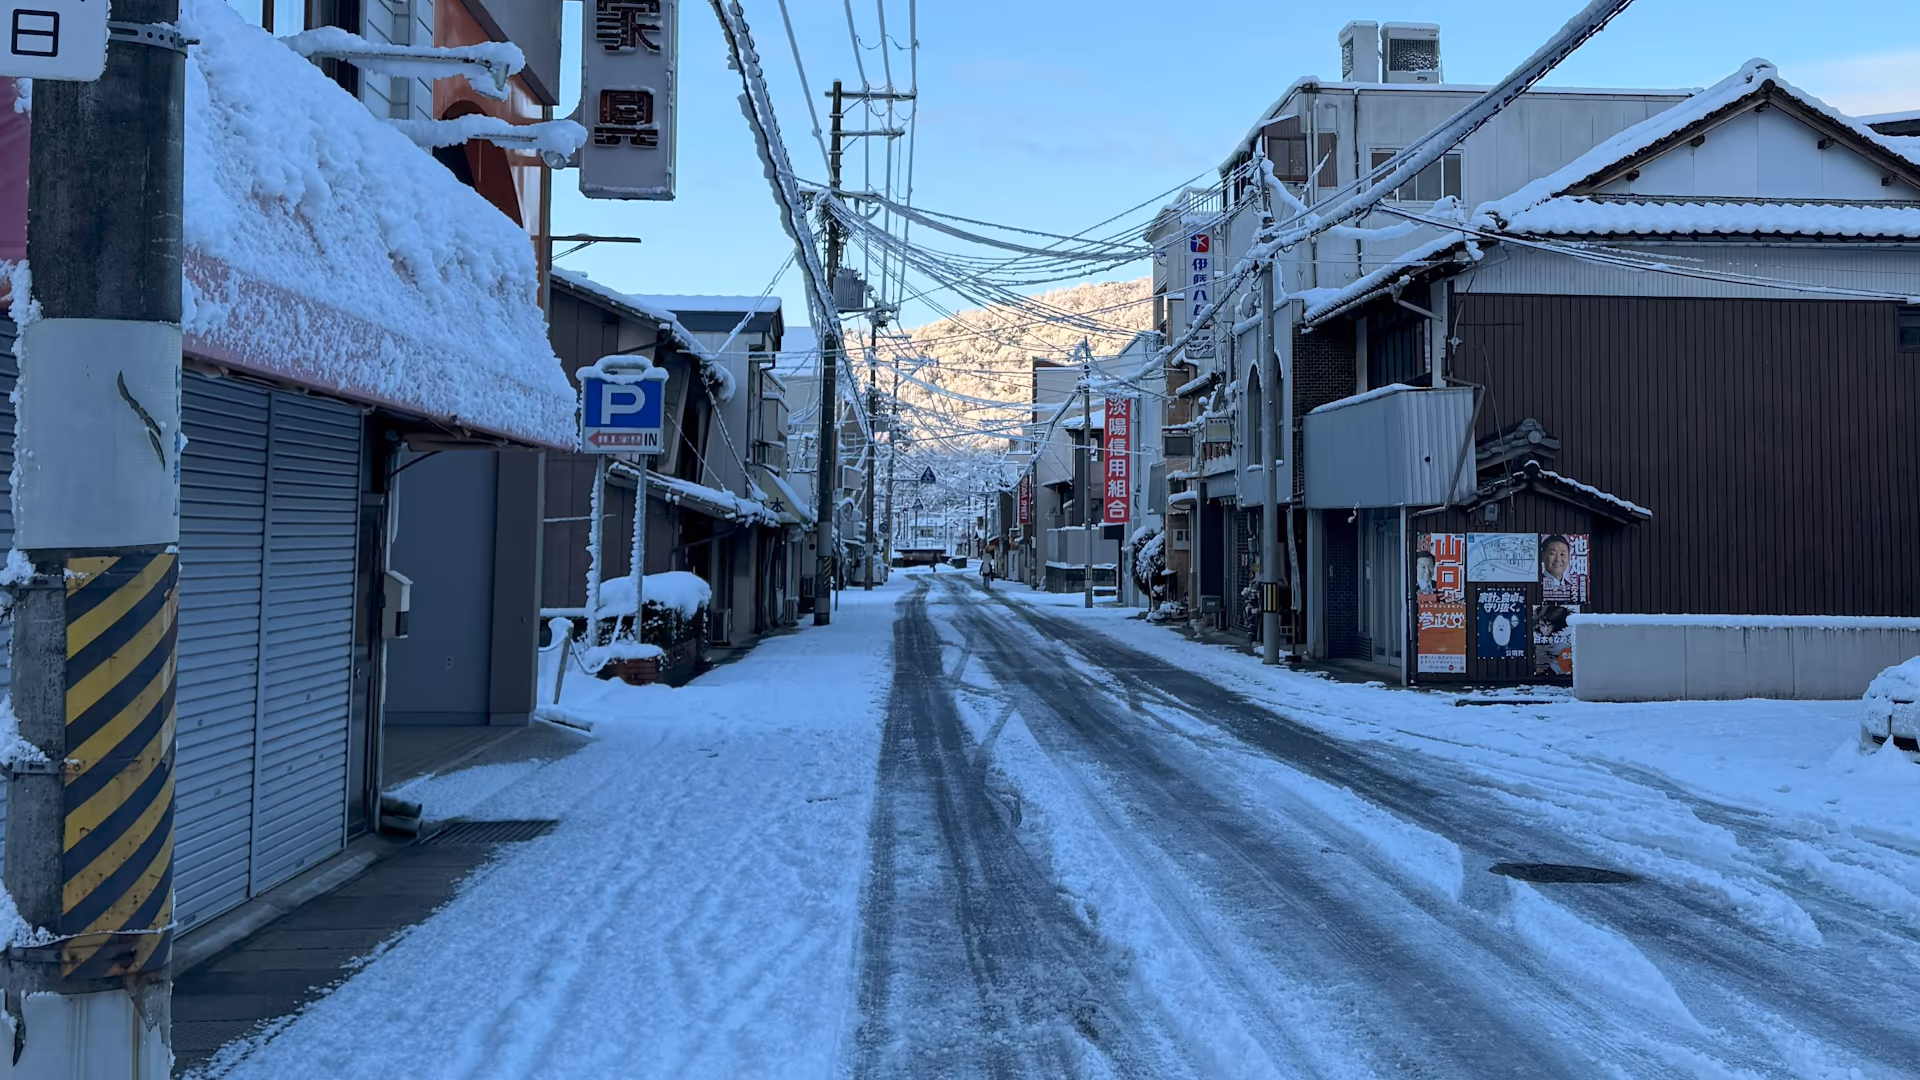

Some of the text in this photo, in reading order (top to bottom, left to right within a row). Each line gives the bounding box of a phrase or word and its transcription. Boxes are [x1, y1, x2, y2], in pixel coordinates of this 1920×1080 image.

[11, 9, 60, 57] 日
[601, 384, 645, 424] P
[644, 433, 657, 446] IN
[1435, 535, 1462, 590] 山口
[1569, 536, 1588, 575] 池畑
[1419, 611, 1465, 630] 参政党
